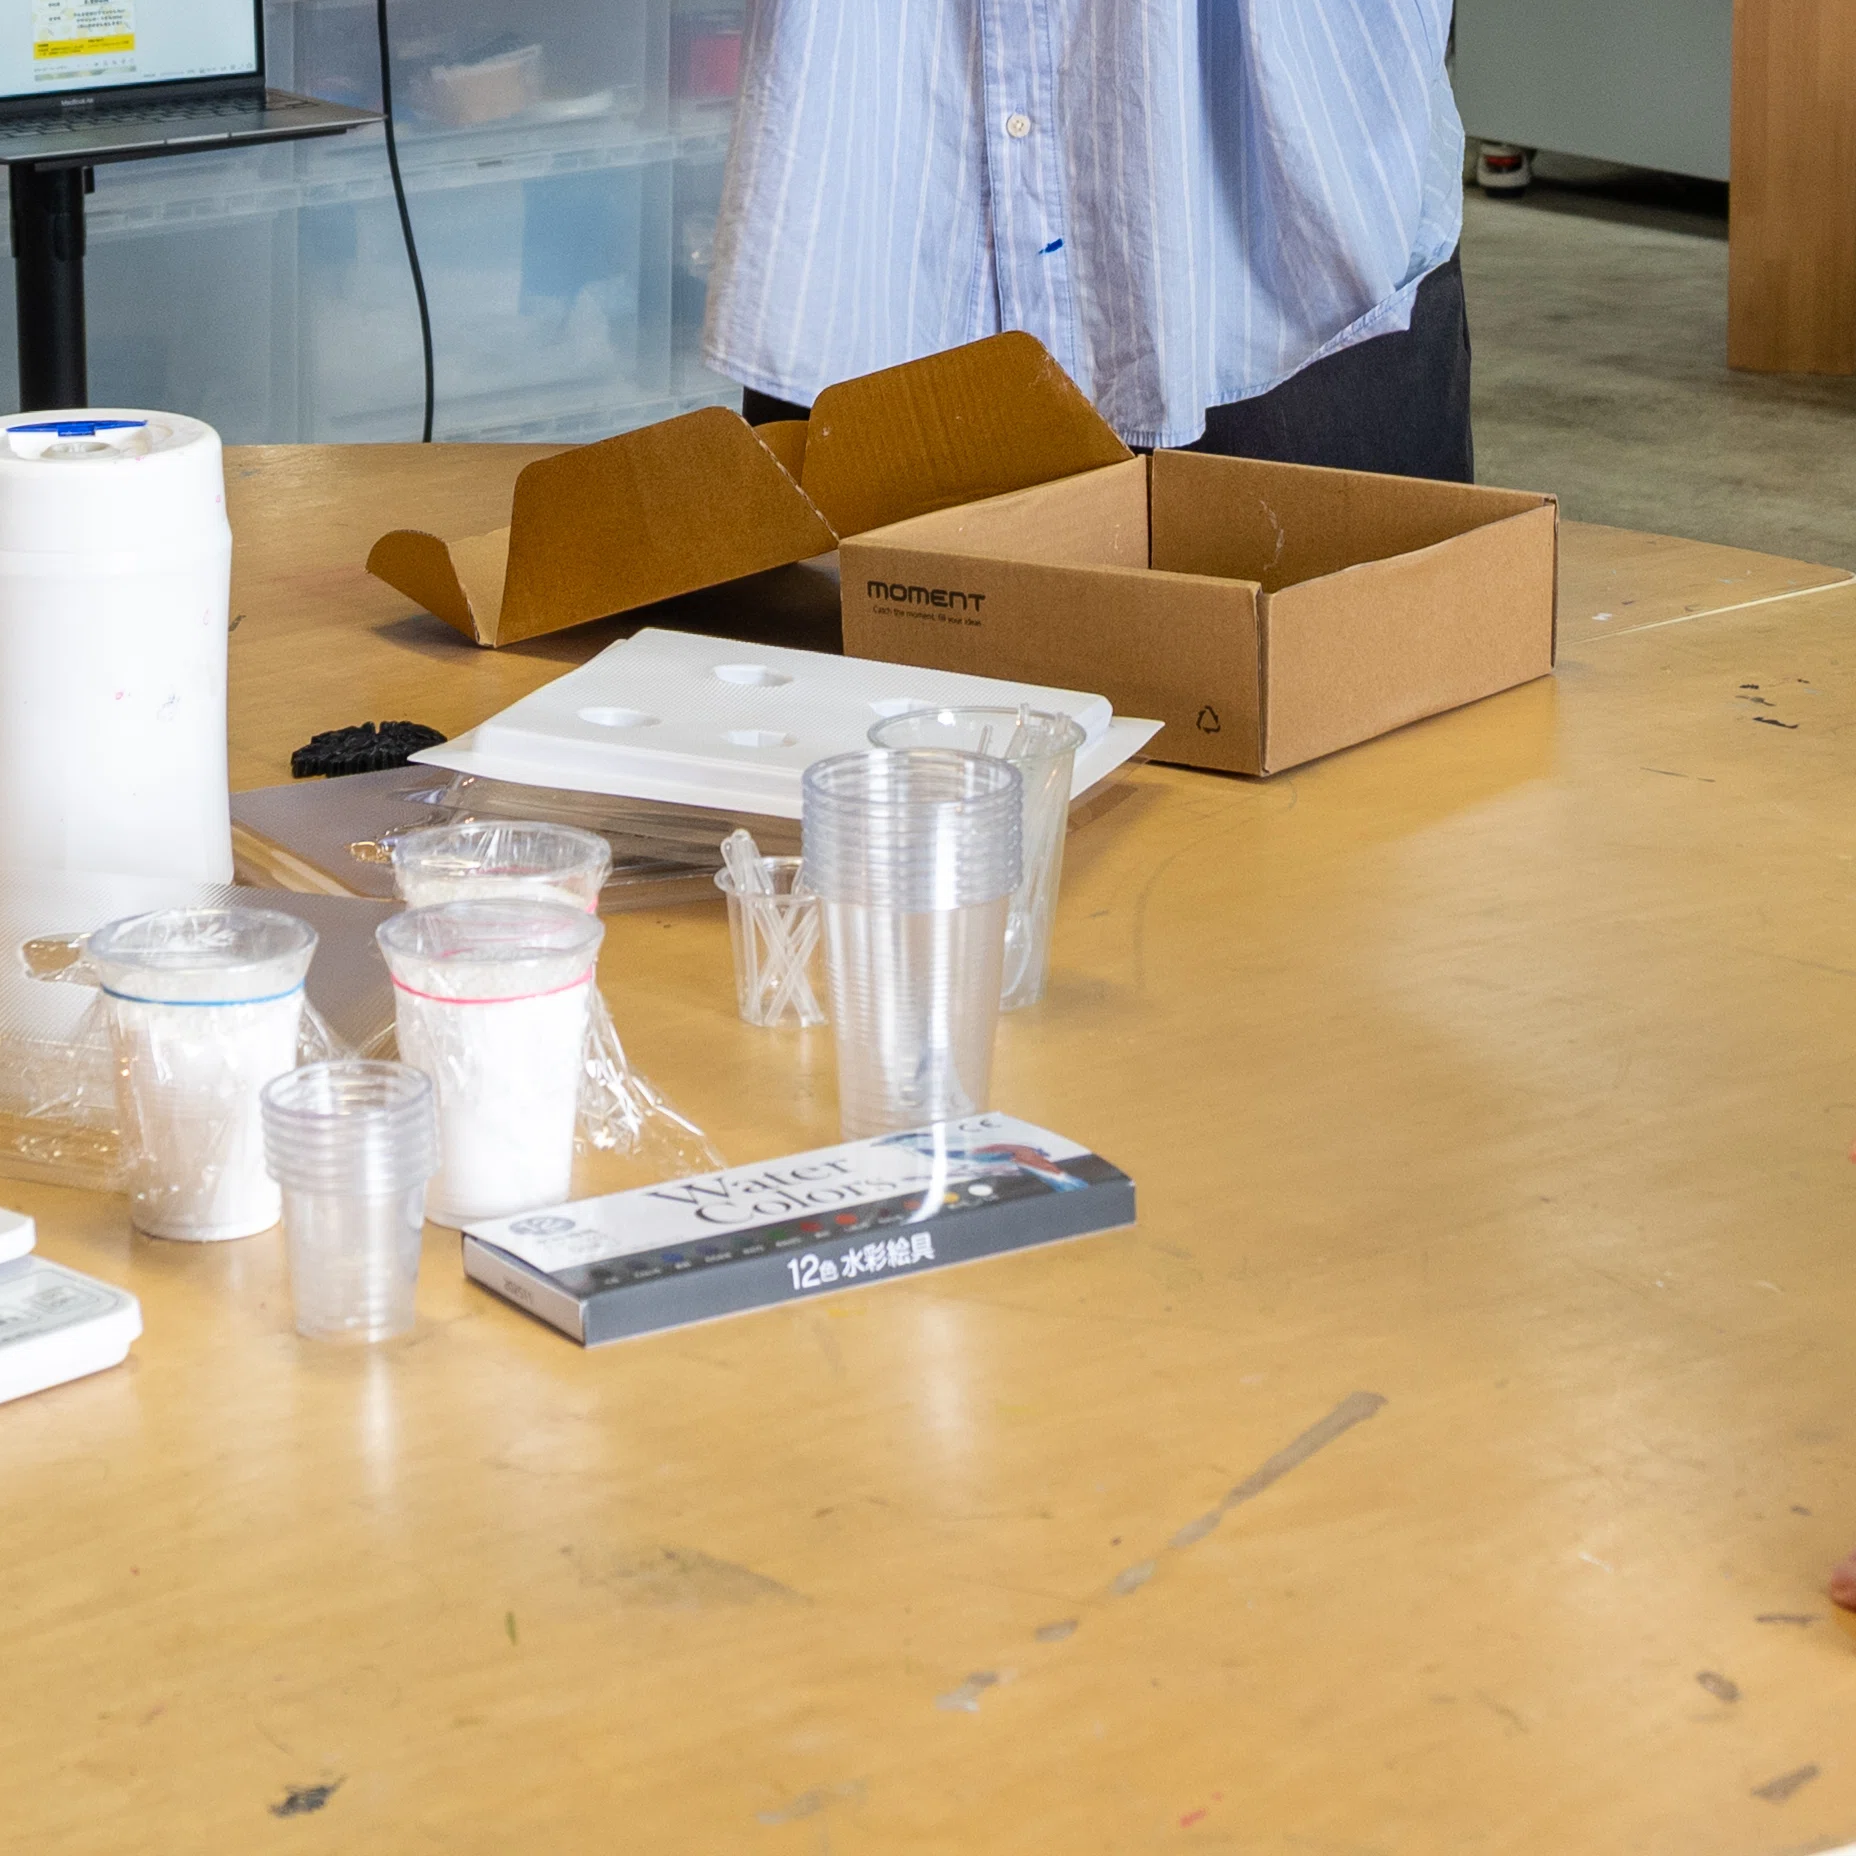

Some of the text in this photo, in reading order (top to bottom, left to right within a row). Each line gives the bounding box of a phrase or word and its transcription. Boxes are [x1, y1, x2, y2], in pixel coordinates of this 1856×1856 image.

[866, 580, 986, 612] MOMENT
[646, 1157, 850, 1206] Water
[695, 1176, 898, 1225] Colors
[786, 1253, 839, 1291] 12色
[841, 1231, 936, 1278] 水彩絵具
